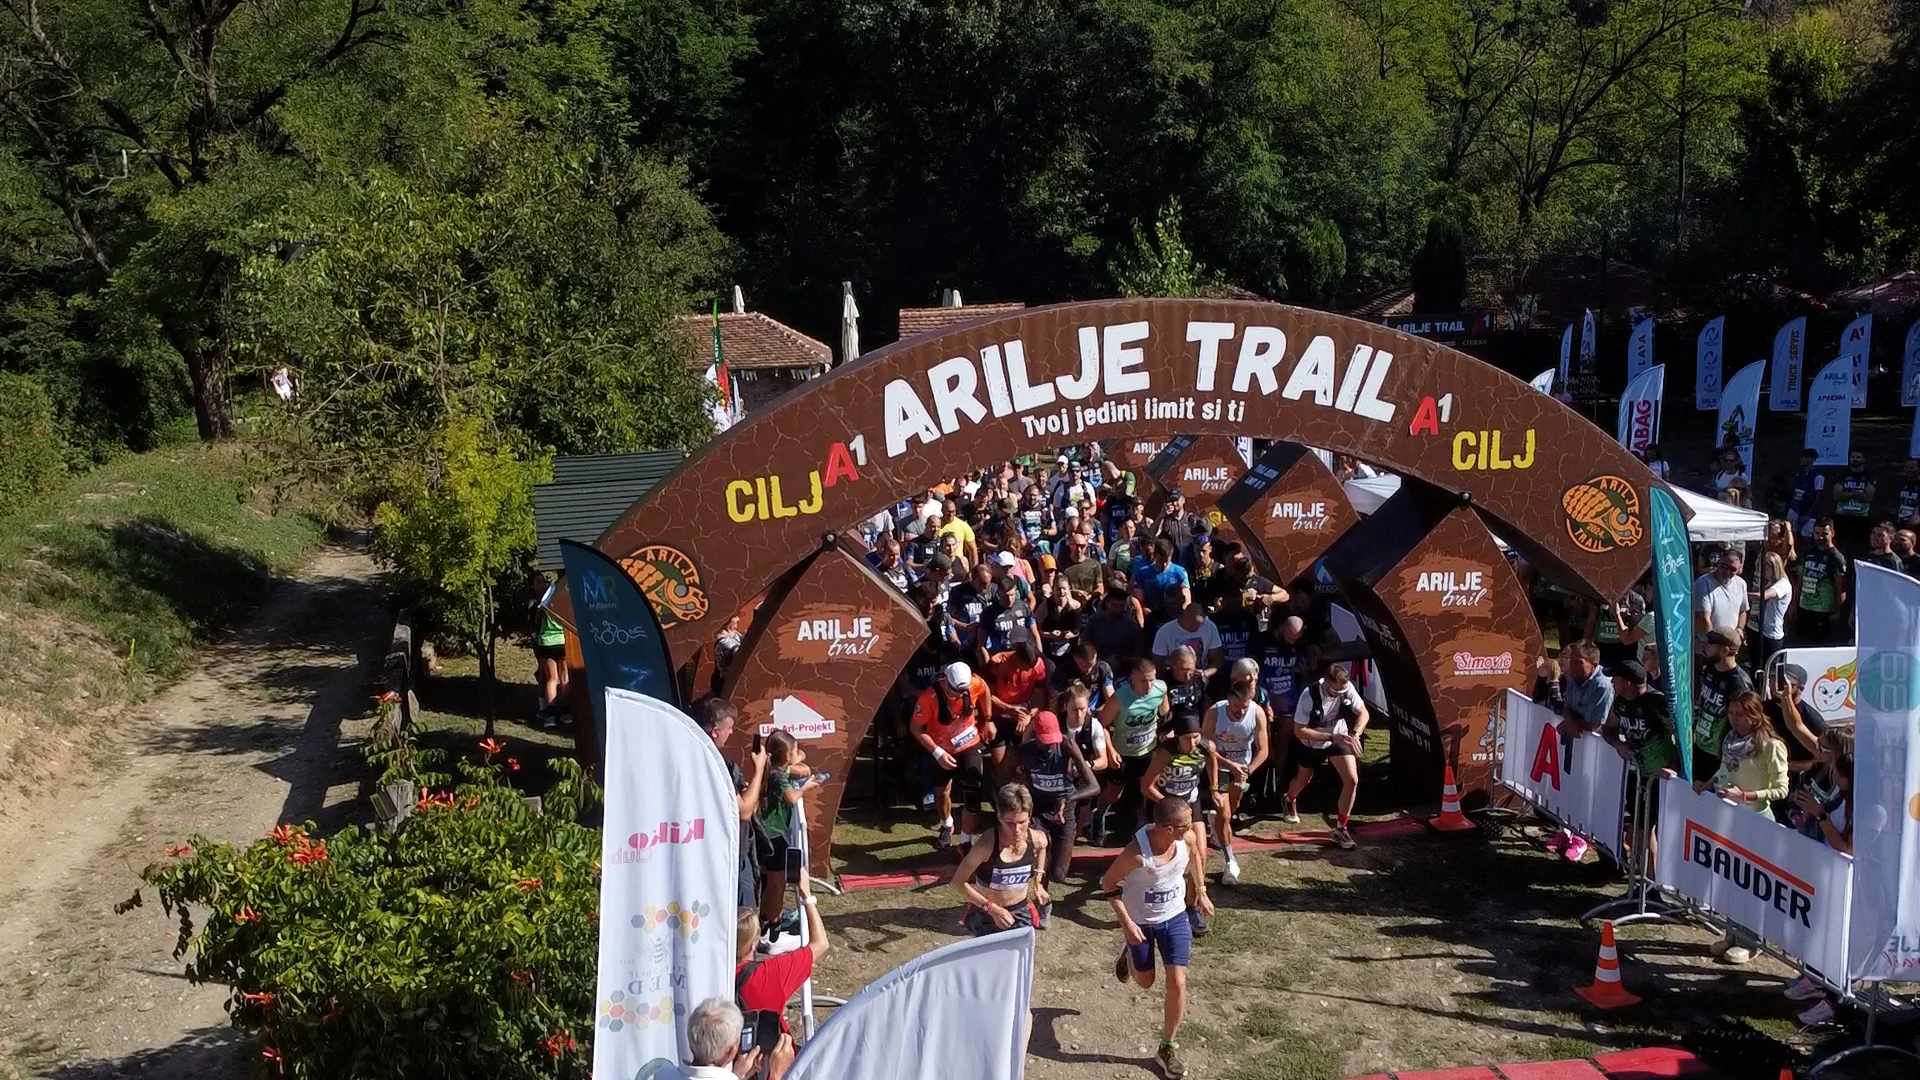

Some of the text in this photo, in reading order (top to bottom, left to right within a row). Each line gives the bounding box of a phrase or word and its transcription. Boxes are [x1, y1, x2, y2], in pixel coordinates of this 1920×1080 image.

[1434, 321, 1465, 332] TRAIL
[1850, 326, 1864, 342] A1
[884, 320, 1396, 458] ARILJE TRAIL
[1022, 397, 1244, 439] Tvoj jedini limit si ti
[1410, 393, 1452, 436] A1
[822, 434, 868, 488] A1
[1451, 429, 1536, 471] CILJ
[1184, 468, 1228, 481] ARILJE
[1201, 478, 1232, 491] trail
[725, 468, 823, 524] CILJ
[1600, 478, 1641, 517] ARILJE
[1272, 502, 1325, 518] ARILJE
[1292, 515, 1328, 531] trail
[1587, 523, 1605, 539] 2024
[1574, 527, 1605, 550] TRAIL
[646, 549, 697, 586] ARILJE
[1416, 571, 1483, 593] ARILJE
[1441, 588, 1488, 608] trail
[797, 617, 872, 643] ARILJE
[828, 638, 878, 657] trail
[1668, 655, 1677, 688] Events
[1530, 722, 1574, 791] A1
[1039, 779, 1063, 787] 2078
[1001, 875, 1028, 885] 2077
[1693, 834, 1813, 928] BAUDER
